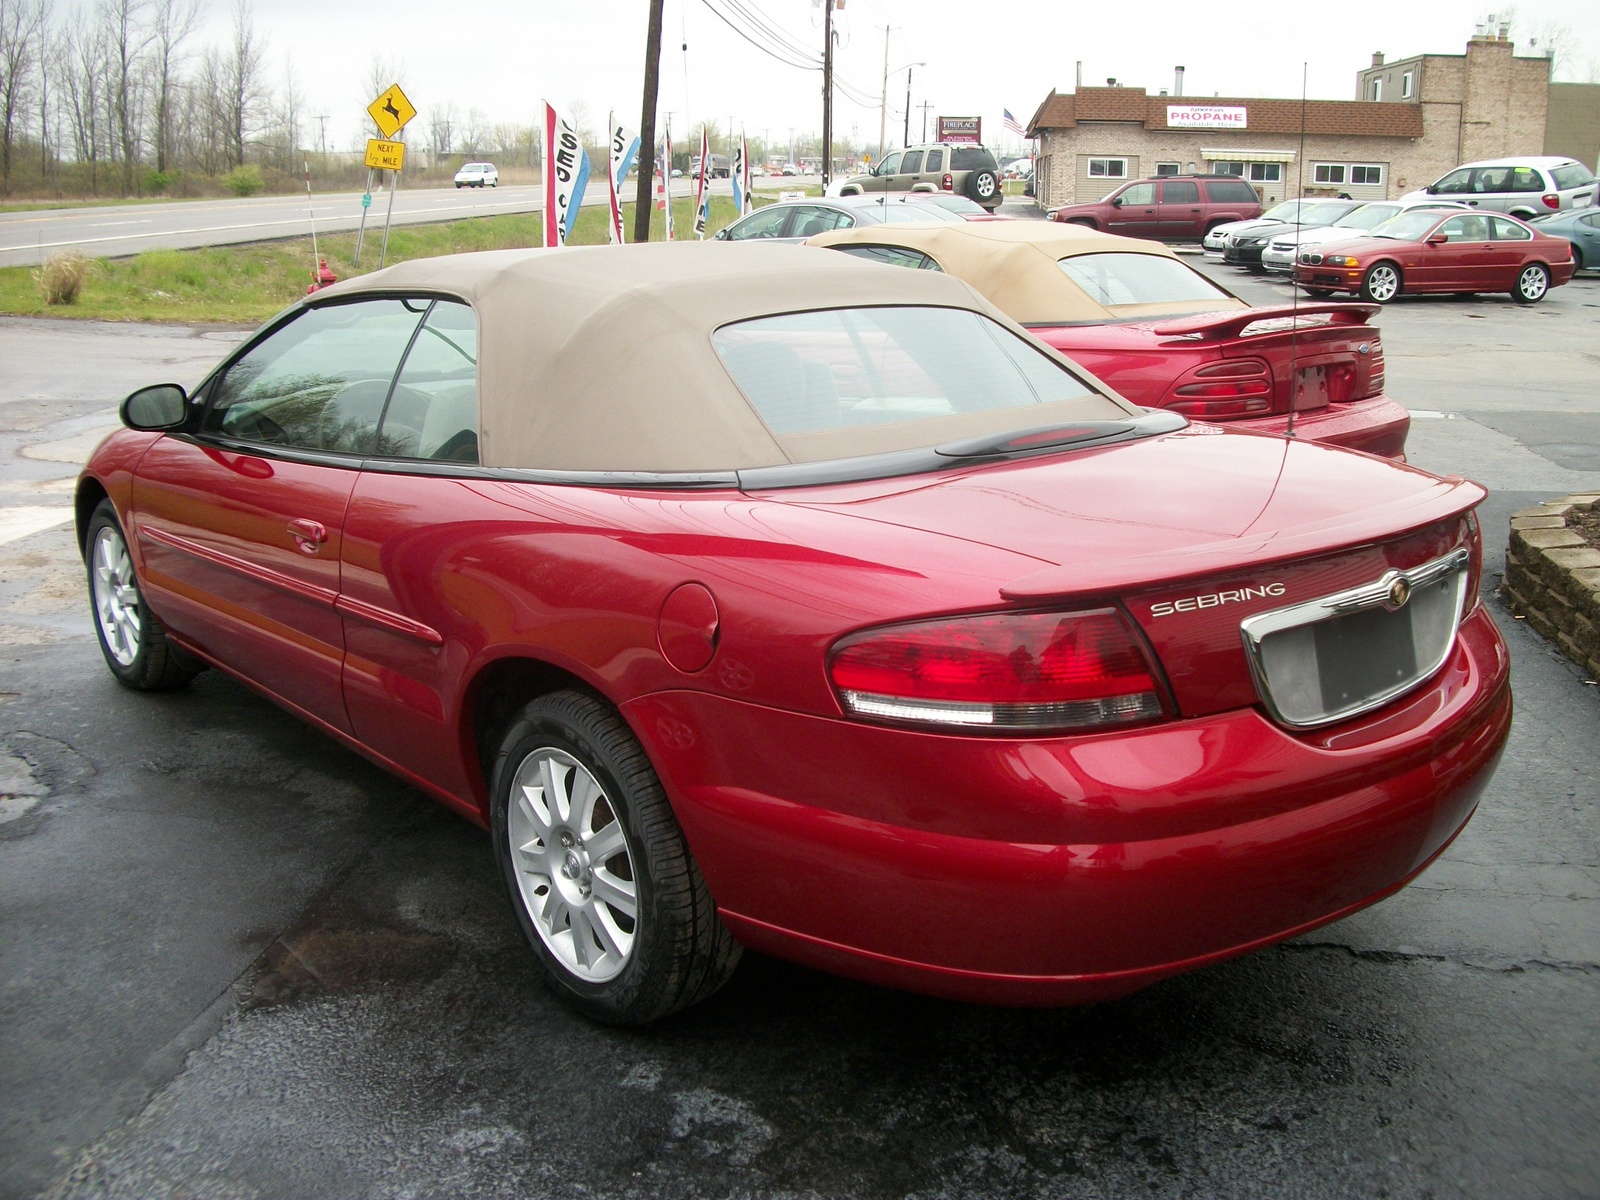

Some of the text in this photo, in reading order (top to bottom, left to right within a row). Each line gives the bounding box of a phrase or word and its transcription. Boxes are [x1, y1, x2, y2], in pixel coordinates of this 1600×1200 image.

[1170, 112, 1243, 122] PROPANE
[377, 143, 395, 154] NEXT
[382, 156, 398, 166] MILE
[1150, 582, 1286, 617] SEBRING
